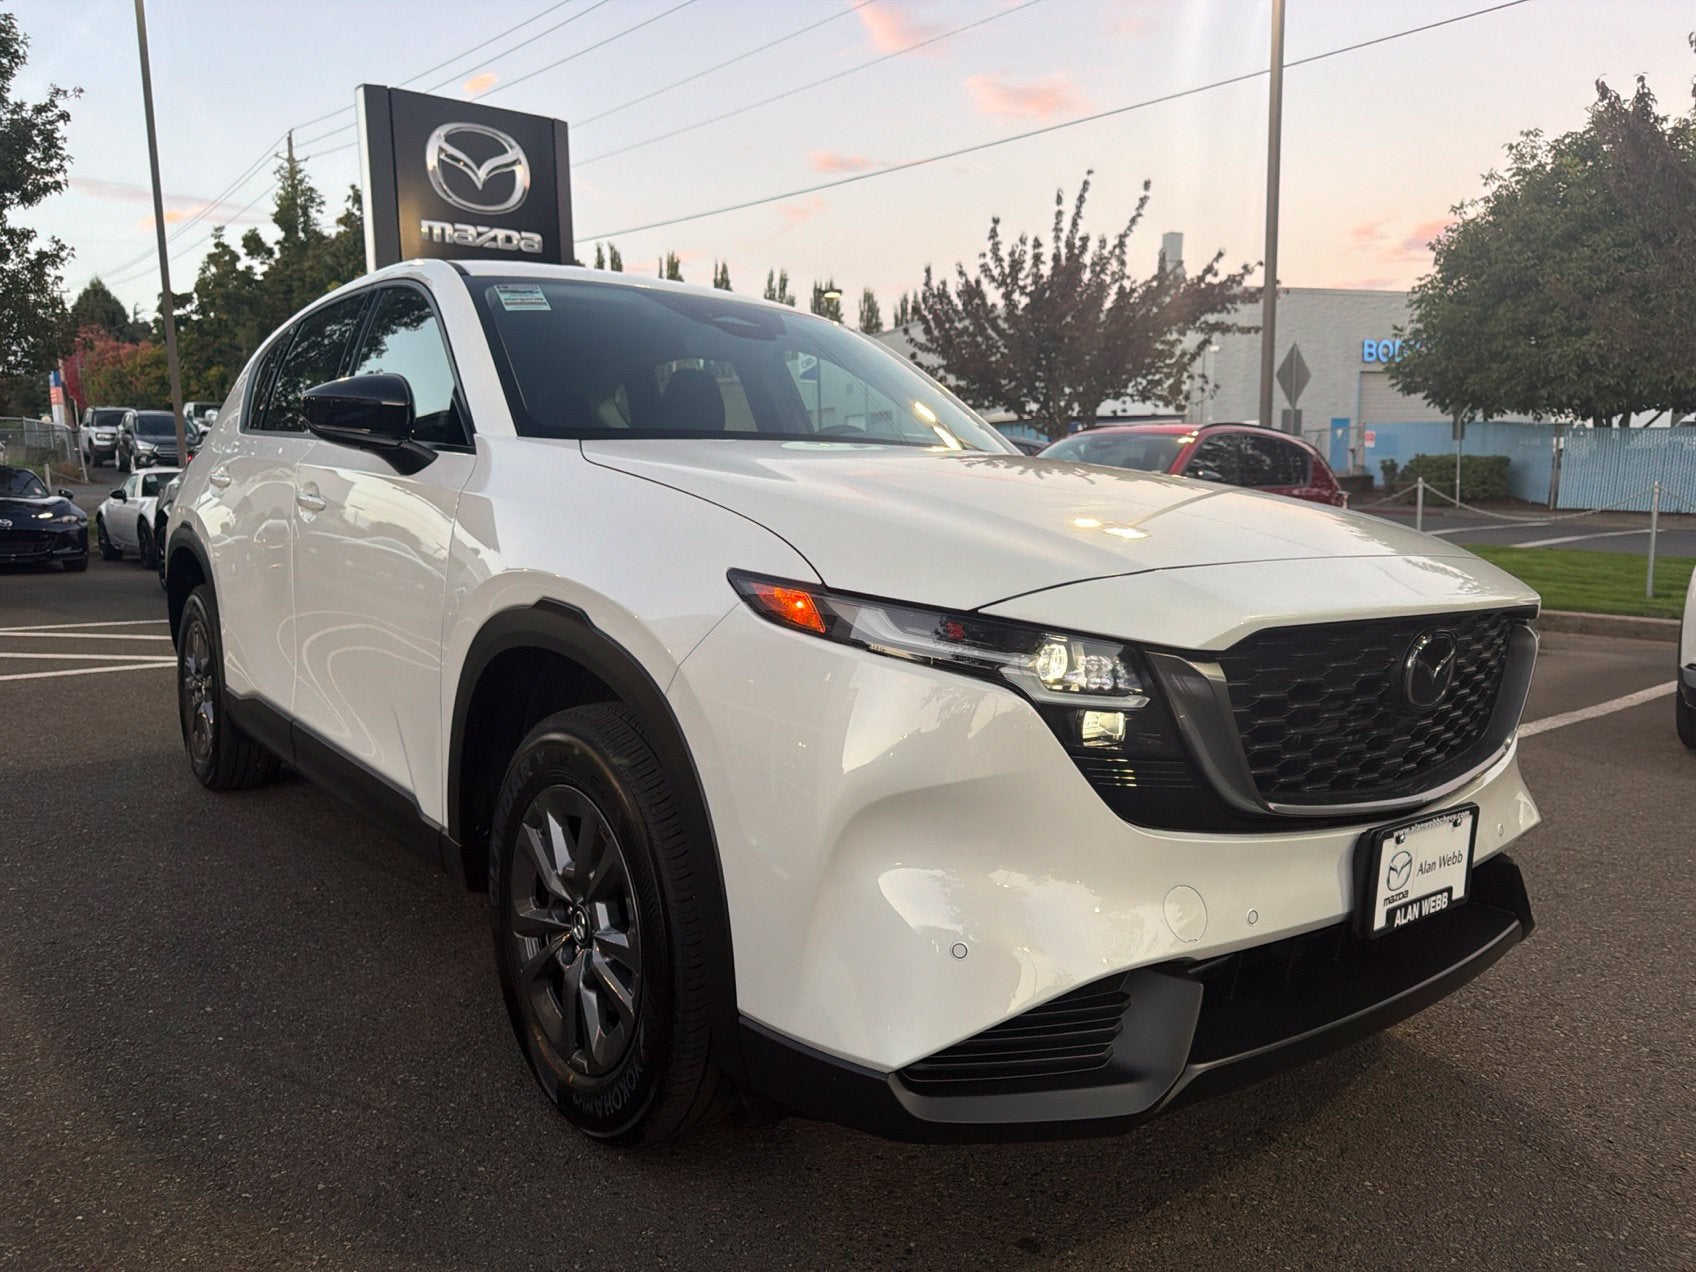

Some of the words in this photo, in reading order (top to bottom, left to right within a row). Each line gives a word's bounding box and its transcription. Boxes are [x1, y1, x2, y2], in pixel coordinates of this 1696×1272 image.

[1416, 861, 1437, 877] Alan
[1439, 850, 1464, 869] Webb
[1394, 901, 1420, 928] ALAN
[1421, 892, 1449, 917] WEBB
